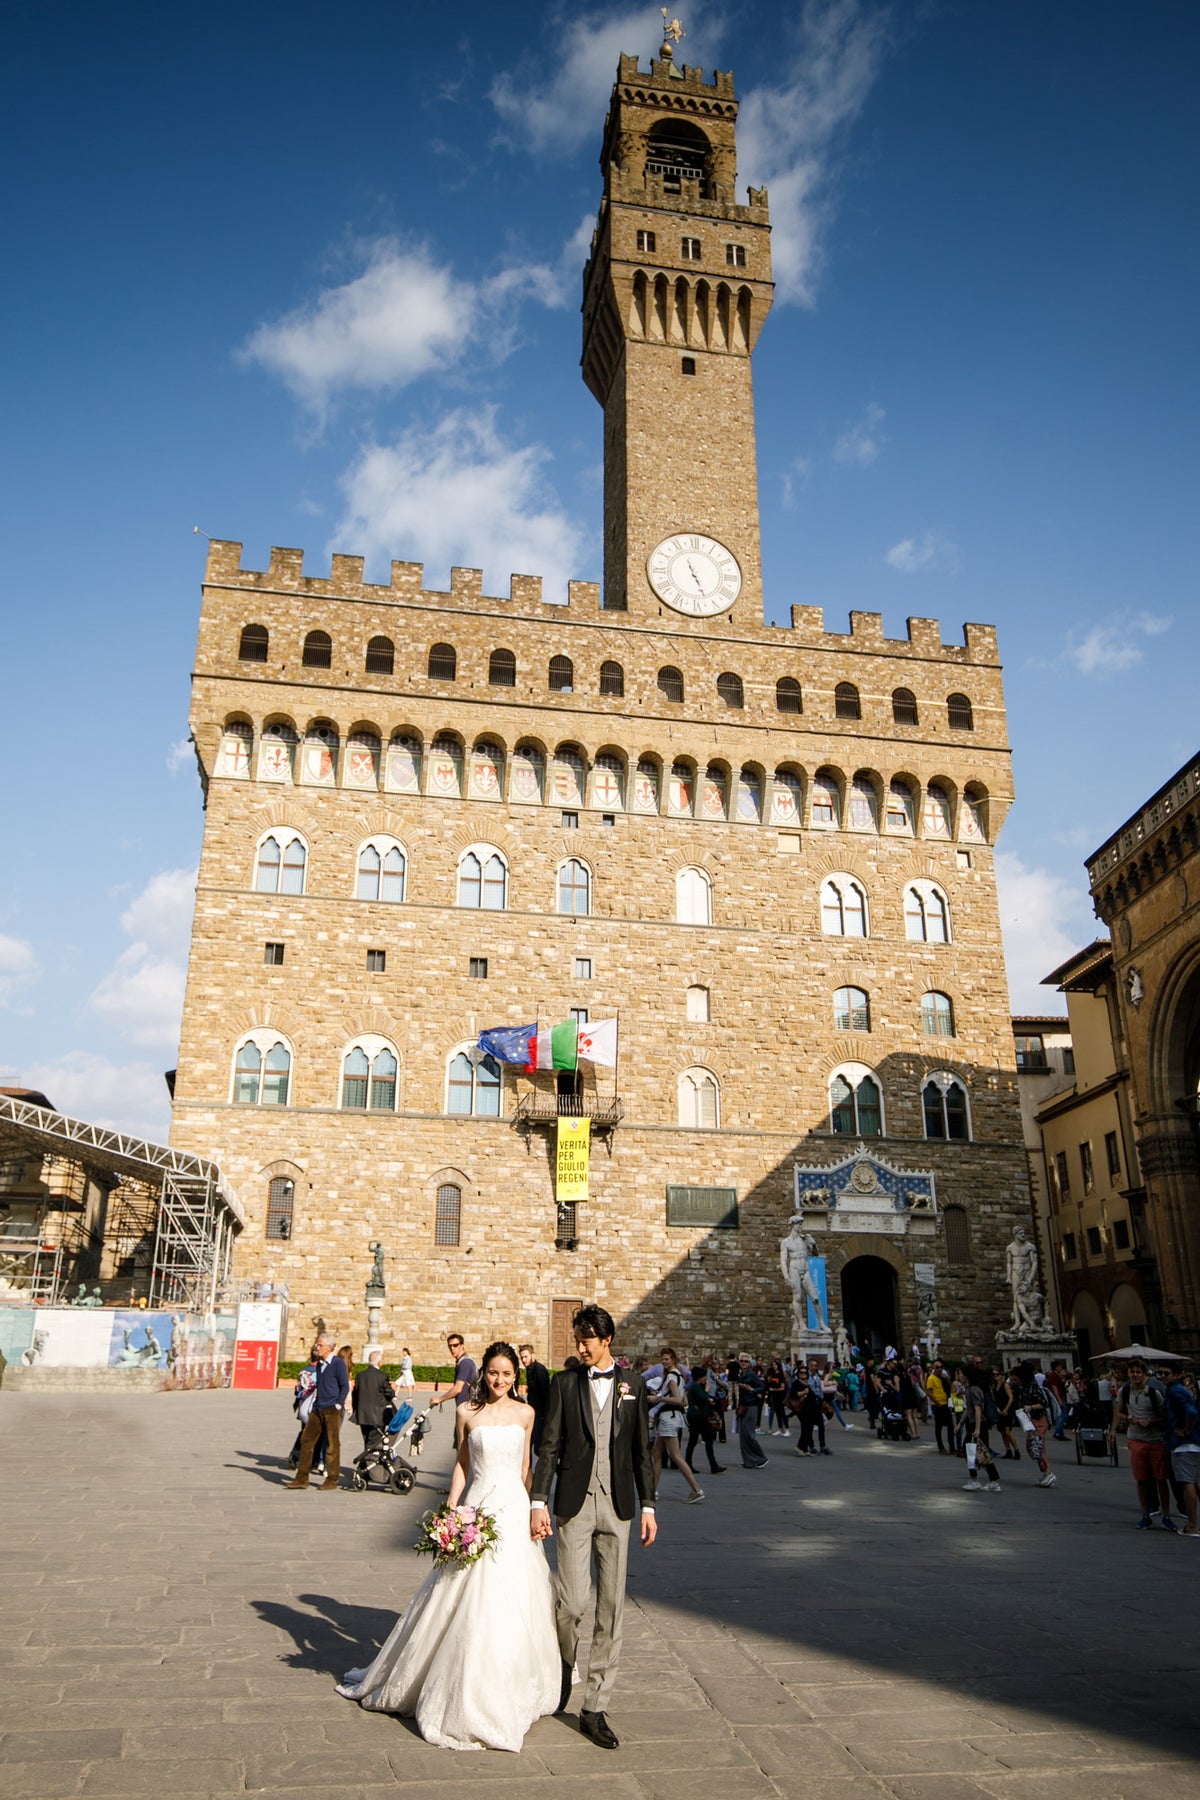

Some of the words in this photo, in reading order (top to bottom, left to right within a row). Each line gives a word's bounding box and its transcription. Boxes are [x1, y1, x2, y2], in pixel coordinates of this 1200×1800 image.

[559, 1139, 587, 1150] VERITÀ
[558, 1151, 575, 1161] PER
[558, 1161, 585, 1171] GIULIO
[558, 1173, 587, 1183] REGENI
